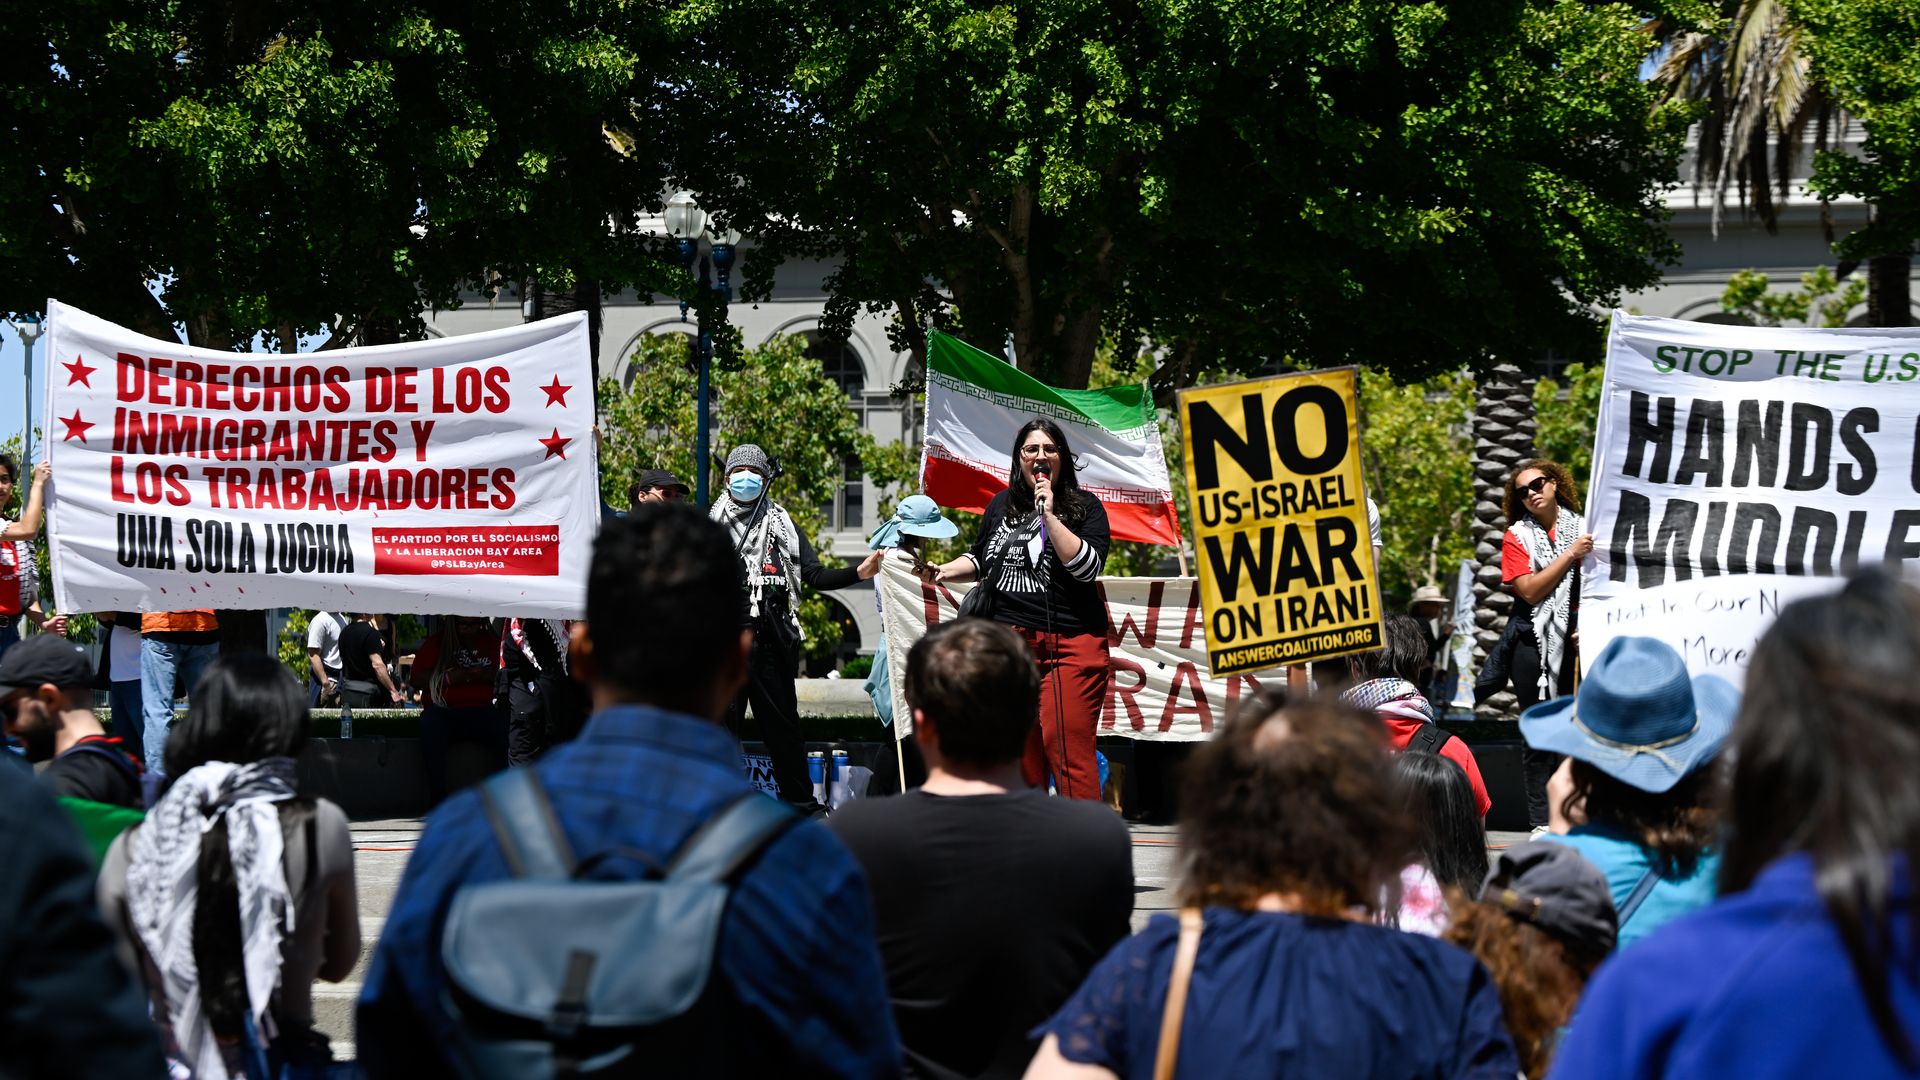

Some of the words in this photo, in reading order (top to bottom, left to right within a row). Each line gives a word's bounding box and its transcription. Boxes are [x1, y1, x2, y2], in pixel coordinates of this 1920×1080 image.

[117, 352, 351, 413] DERECHOS
[365, 366, 418, 413] DE
[432, 366, 511, 414] LOS
[1653, 345, 1753, 376] STOP
[1774, 350, 1845, 381] THE
[112, 406, 398, 463] INMIGRANTES
[410, 420, 436, 462] Y
[1188, 384, 1349, 491] NO
[1622, 390, 1880, 496] HANDS
[110, 455, 191, 506] LOS
[203, 467, 516, 511] TRABAJADORES
[1198, 474, 1355, 528] US-ISRAEL
[116, 512, 176, 570] UNA
[185, 518, 257, 573] SOLA
[263, 522, 355, 574] LUCHA
[374, 535, 389, 544] EL
[391, 535, 441, 544] PARTIDO
[445, 534, 469, 543] POR
[471, 534, 486, 543] EL
[489, 533, 558, 543] SOCIALISMO
[384, 547, 393, 556] Y
[396, 547, 411, 556] LA
[413, 547, 483, 556] LIBERACION
[486, 547, 509, 556] BAY
[512, 547, 543, 556] AREA
[430, 559, 505, 570] @PSLBayArea
[1203, 516, 1365, 603] WAR
[1213, 602, 1263, 643] ON
[1274, 584, 1370, 634] IRAN!
[1695, 589, 1751, 612] Our
[1218, 628, 1372, 669] ANSWERCOALITION.ORG
